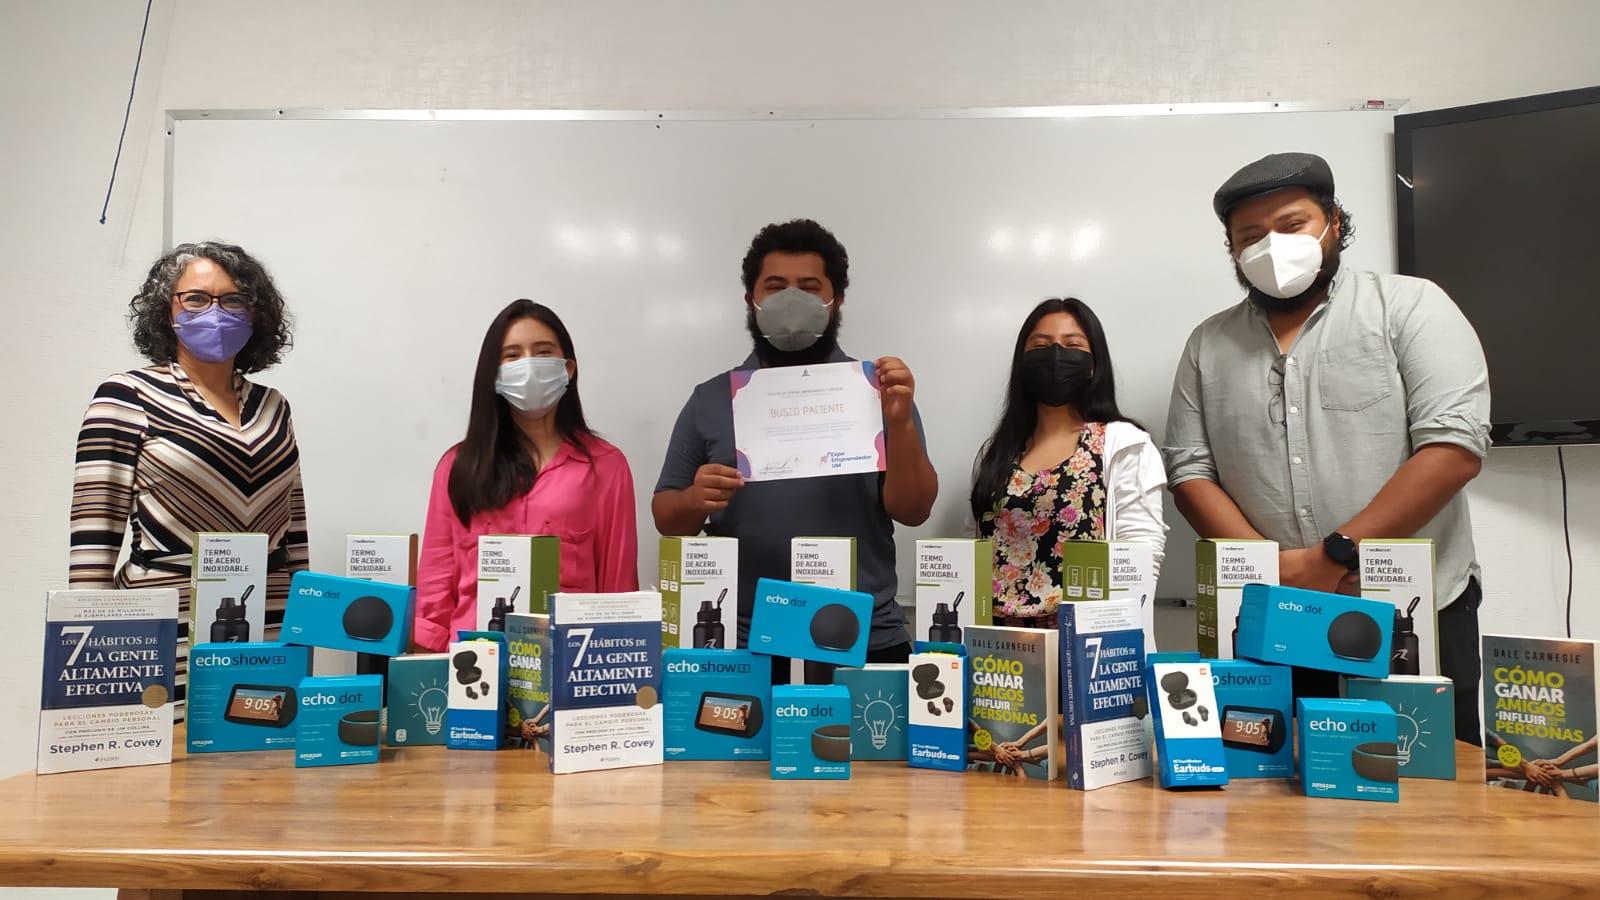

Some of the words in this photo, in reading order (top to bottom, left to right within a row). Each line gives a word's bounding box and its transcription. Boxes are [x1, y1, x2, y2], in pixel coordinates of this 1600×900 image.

[770, 407, 799, 417] BUSCO
[803, 404, 844, 415] PACIENTE
[299, 587, 322, 597] echo
[324, 590, 340, 599] dot
[766, 594, 789, 605] echo
[790, 598, 806, 607] dot
[1279, 602, 1303, 612] echo
[1304, 604, 1322, 615] dot
[61, 626, 94, 666] 7
[88, 636, 142, 646] HÁBITOS
[509, 639, 541, 657] CÓMO
[567, 628, 594, 668] 7
[590, 638, 634, 648] HÁBITOS
[972, 639, 991, 648] DALE
[995, 640, 1036, 653] CARNEGIE
[85, 652, 104, 662] LA
[109, 650, 159, 662] GENTE
[195, 653, 230, 666] echo
[232, 653, 271, 665] show
[509, 655, 541, 670] GANAR
[588, 654, 603, 665] LA
[606, 652, 648, 663] GENTE
[1086, 637, 1102, 679] 7
[1100, 647, 1128, 658] HÁBITOS
[1493, 648, 1520, 659] DALE
[1525, 651, 1581, 664] CARNEGIE
[667, 660, 699, 673] echo
[701, 661, 736, 672] show
[973, 654, 1024, 675] CÓMO
[1100, 665, 1110, 675] LA
[1112, 661, 1138, 673] GENTE
[59, 665, 164, 681] ALTAMENTE
[567, 666, 653, 683] ALTAMENTE
[1221, 672, 1258, 685] show
[1494, 665, 1565, 688] CÓMO
[973, 672, 1024, 690] GANAR
[1088, 676, 1142, 694] ALTAMENTE
[65, 682, 143, 697] EFECTIVA
[573, 683, 638, 697] EFECTIVA
[973, 686, 1024, 702] AMIGOS
[1495, 683, 1565, 703] GANAR
[243, 698, 270, 711] 9:05
[302, 693, 335, 705] echo
[339, 692, 362, 704] dot
[975, 698, 1010, 710] INFLUIR
[1093, 693, 1134, 710] EFECTIVA
[713, 706, 737, 720] 9:05
[776, 704, 808, 716] echo
[811, 705, 833, 716] dot
[1496, 699, 1566, 717] AMIGOS
[973, 707, 1037, 726] PERSONAS
[1499, 711, 1546, 726] INFLUIR
[1236, 721, 1260, 735] 9:05
[1310, 718, 1347, 732] echo
[1351, 719, 1376, 733] dot
[1496, 720, 1584, 743] PERSONAS
[451, 730, 481, 739] Earbuds
[50, 741, 104, 754] Stephen
[108, 741, 120, 749] R.
[124, 738, 162, 748] Covey
[564, 742, 607, 754] Stephen
[611, 741, 620, 750] R.
[624, 739, 655, 749] Covey
[912, 748, 946, 759] Earbuds
[1090, 757, 1119, 769] Stephen
[1120, 755, 1127, 763] R.
[1129, 752, 1148, 761] Covey
[1174, 763, 1211, 773] Earbuds
